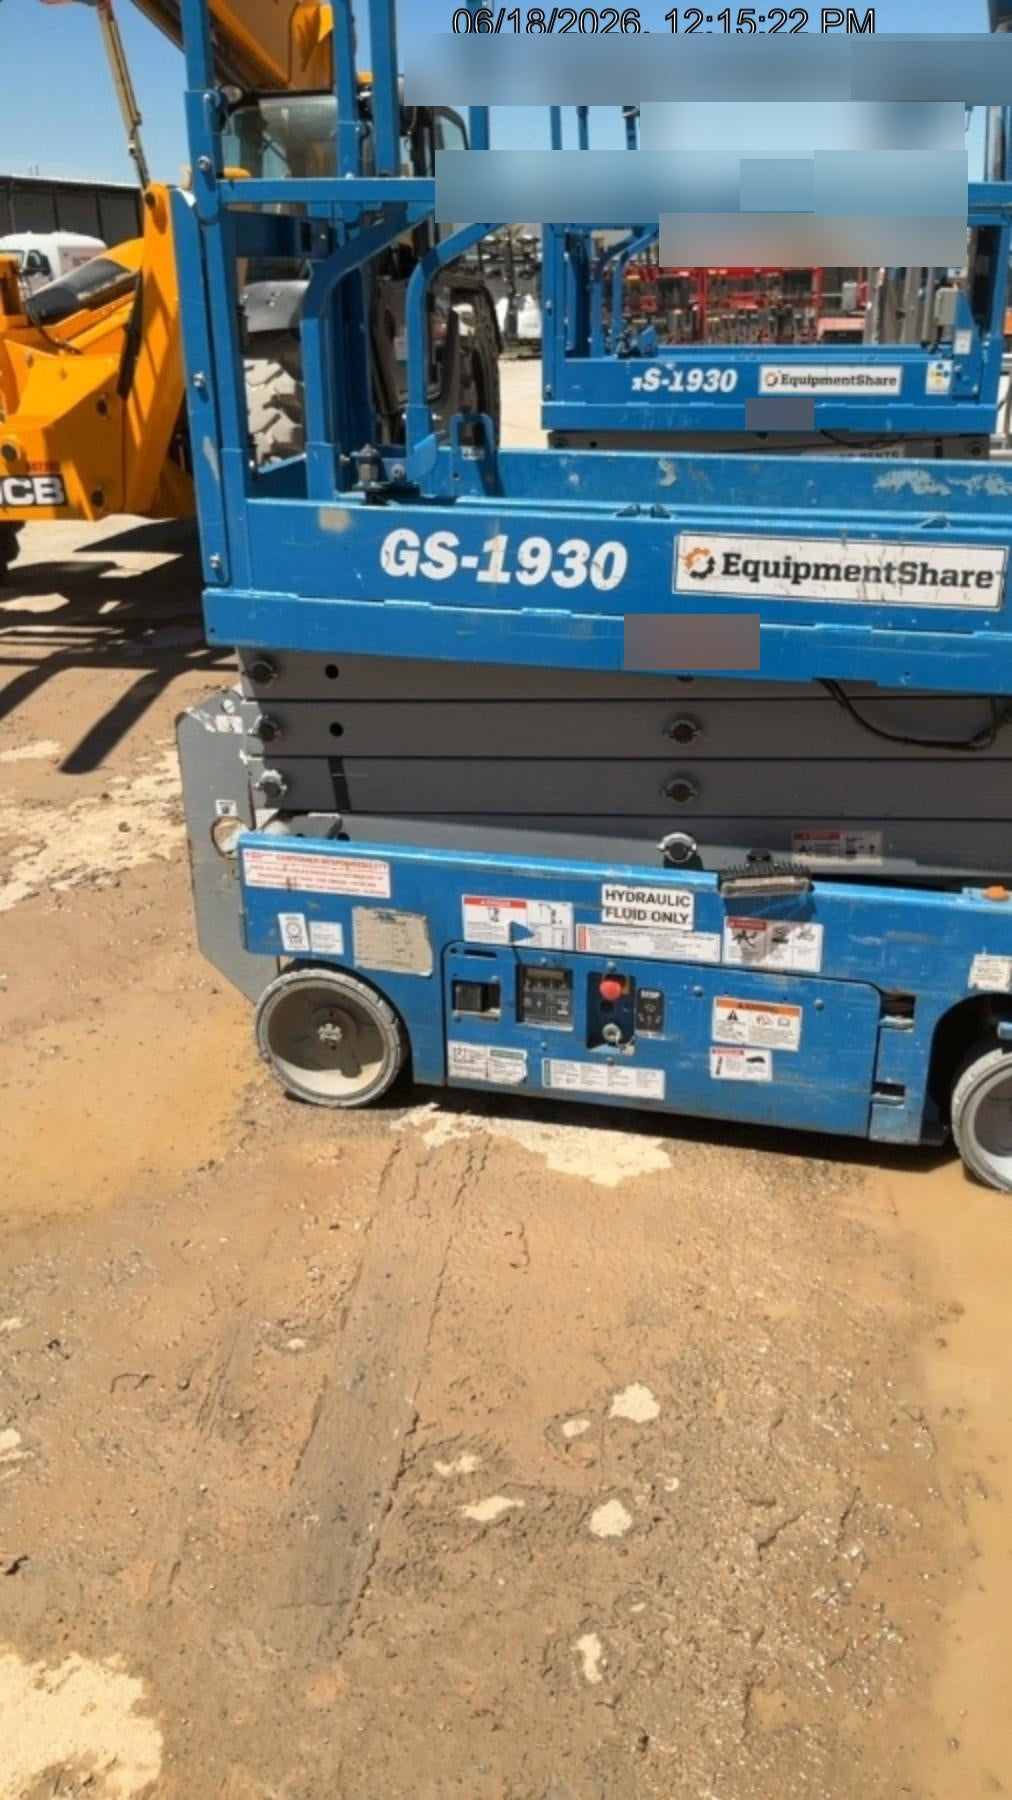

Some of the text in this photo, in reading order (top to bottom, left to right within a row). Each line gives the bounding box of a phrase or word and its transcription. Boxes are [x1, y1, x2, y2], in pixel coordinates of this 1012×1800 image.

[780, 373, 897, 388] EquipmentShare
[0, 477, 64, 504] CB
[380, 528, 628, 591] GS-1930
[720, 553, 994, 592] EquipmentShare
[605, 889, 690, 908] HYDRAULIC
[605, 907, 689, 924] FLUID ONLY
